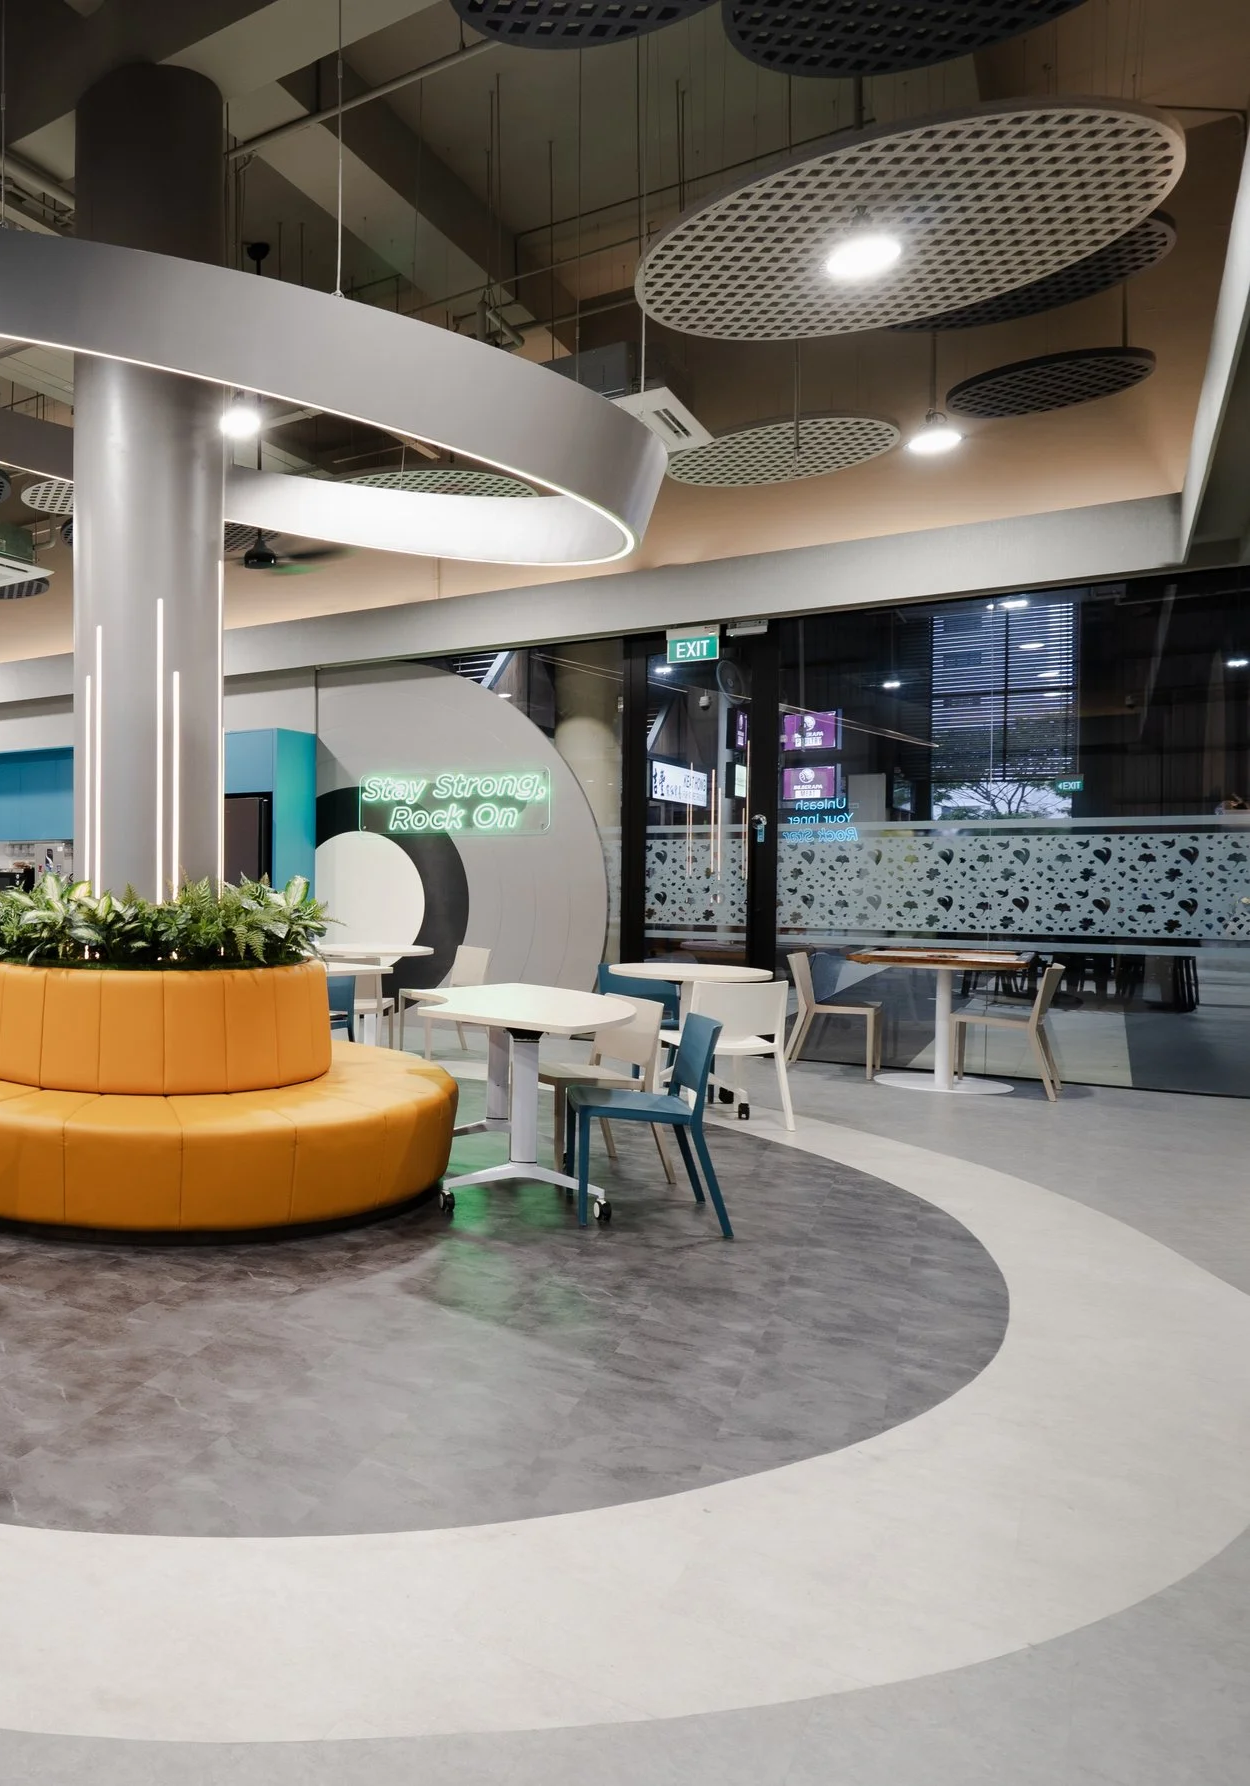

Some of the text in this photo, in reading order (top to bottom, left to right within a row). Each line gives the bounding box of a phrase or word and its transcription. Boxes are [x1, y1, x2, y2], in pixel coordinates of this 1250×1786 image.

[676, 640, 710, 659] EXIT
[362, 773, 547, 805] Stay Strong,
[1062, 781, 1082, 790] EXIT
[389, 803, 519, 831] Rock On
